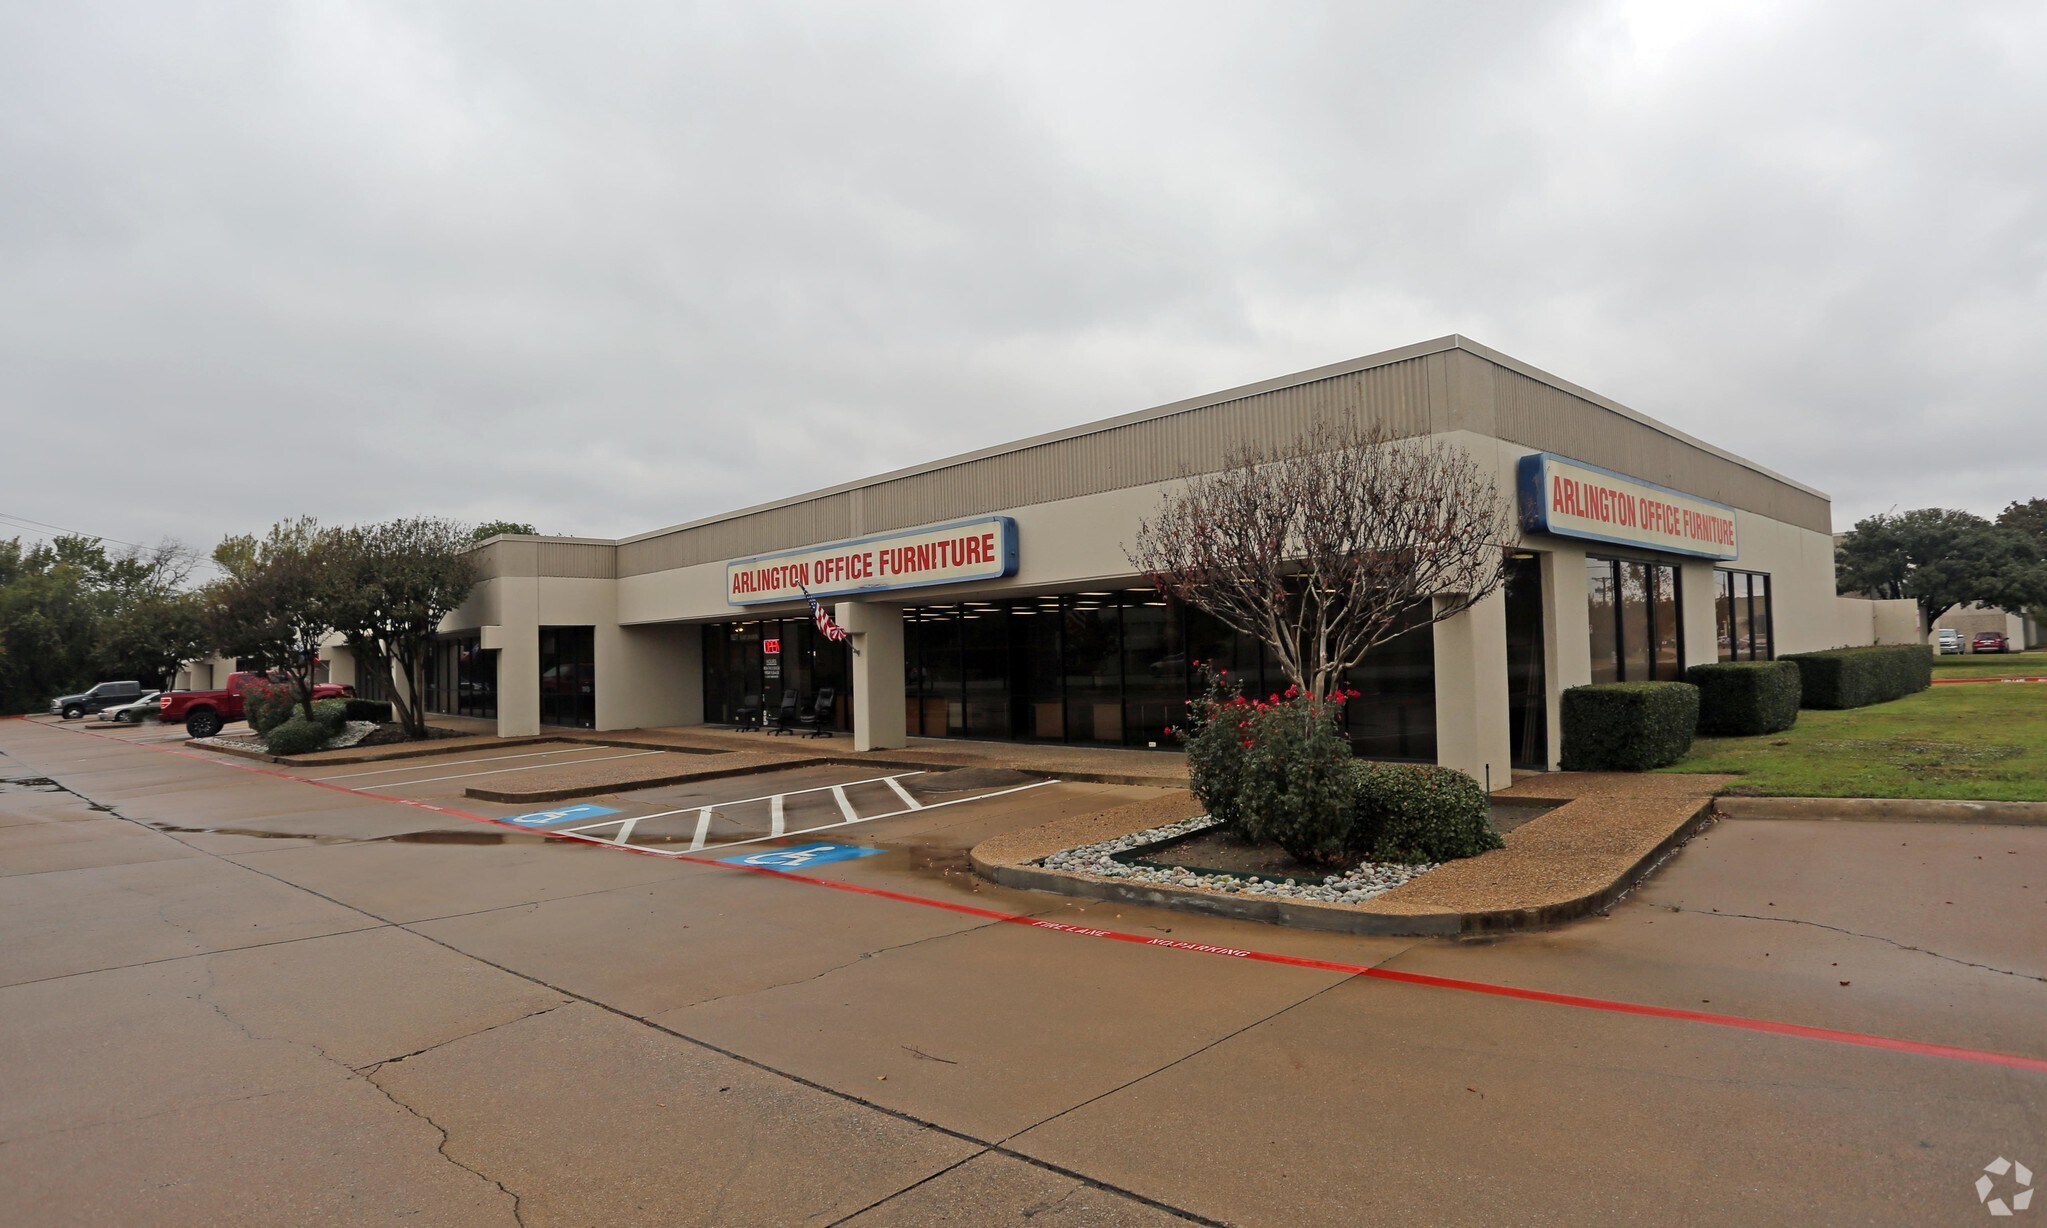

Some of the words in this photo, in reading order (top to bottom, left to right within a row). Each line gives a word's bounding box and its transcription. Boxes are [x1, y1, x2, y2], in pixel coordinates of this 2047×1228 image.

[1553, 475, 1637, 528] ARLINGTON
[1640, 498, 1682, 536] OFFICE
[1682, 508, 1735, 546] FURNITURE
[732, 562, 810, 594] ARLINGTON
[814, 552, 873, 585] OFFICE
[879, 533, 995, 576] FURNITURE
[1032, 919, 1069, 931] FIRE
[1065, 926, 1111, 938] LANE
